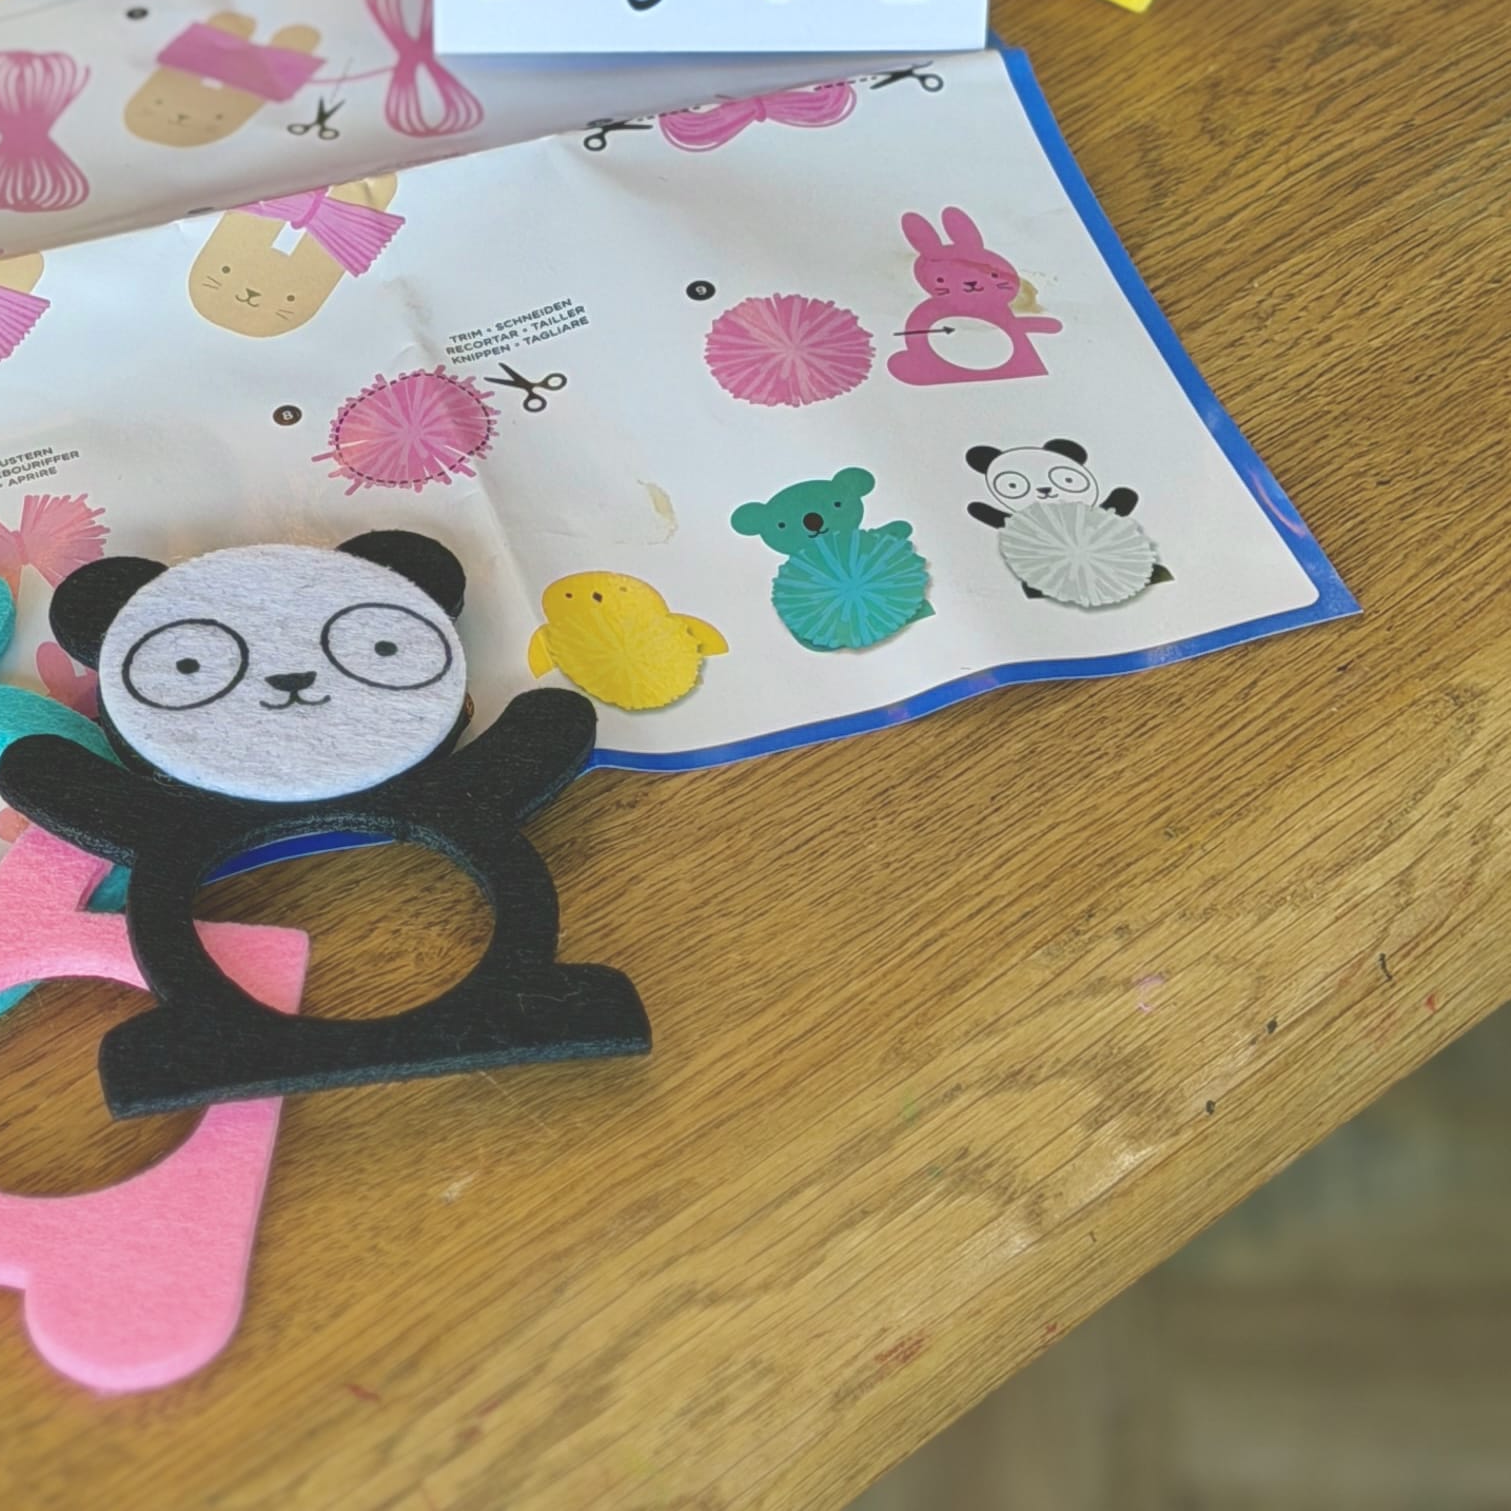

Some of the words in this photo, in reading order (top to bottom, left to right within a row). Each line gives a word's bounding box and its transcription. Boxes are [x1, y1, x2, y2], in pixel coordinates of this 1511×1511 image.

[445, 329, 519, 356] RECORTAR
[531, 304, 586, 330] TAILLER
[449, 328, 483, 345] TRIM
[495, 297, 573, 332] SCHNEIDEN
[451, 343, 511, 365] KNIPPEN
[523, 315, 590, 346] TAGLIARE
[8, 465, 59, 488] APRIRE
